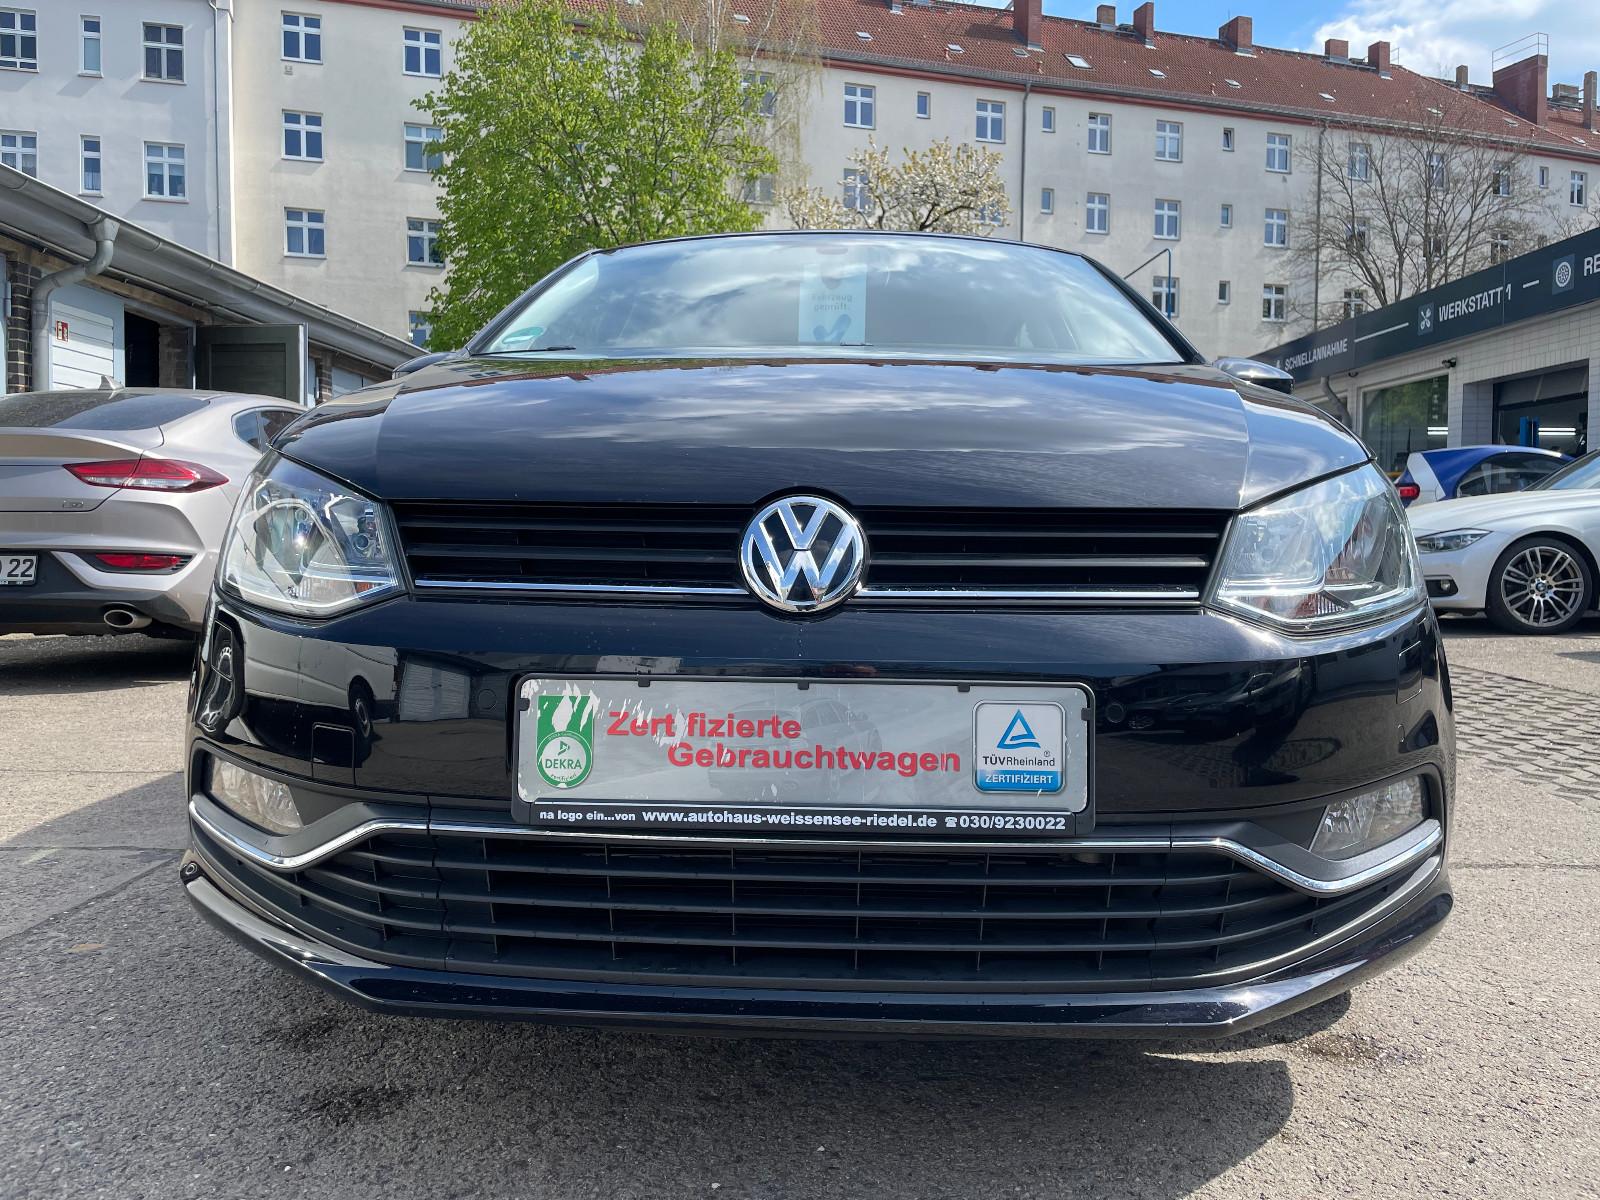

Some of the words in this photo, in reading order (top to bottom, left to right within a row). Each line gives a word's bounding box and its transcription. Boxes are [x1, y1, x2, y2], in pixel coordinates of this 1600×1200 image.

[1439, 286, 1503, 321] WERKSTATT
[1505, 284, 1512, 300] 1
[1284, 338, 1348, 372] SCHNELLANNAHME
[7, 559, 34, 577] 22
[607, 711, 801, 738] Zertfizierte
[545, 758, 582, 769] DEKRA
[667, 742, 961, 777] Gebrauchtwagen
[985, 774, 1053, 784] ZERTIFIZIERT
[539, 811, 554, 819] na
[557, 810, 583, 821] logo
[642, 811, 937, 827] www.autohaus-weissensee-riedel.de
[959, 815, 1066, 830] 030/9230022
